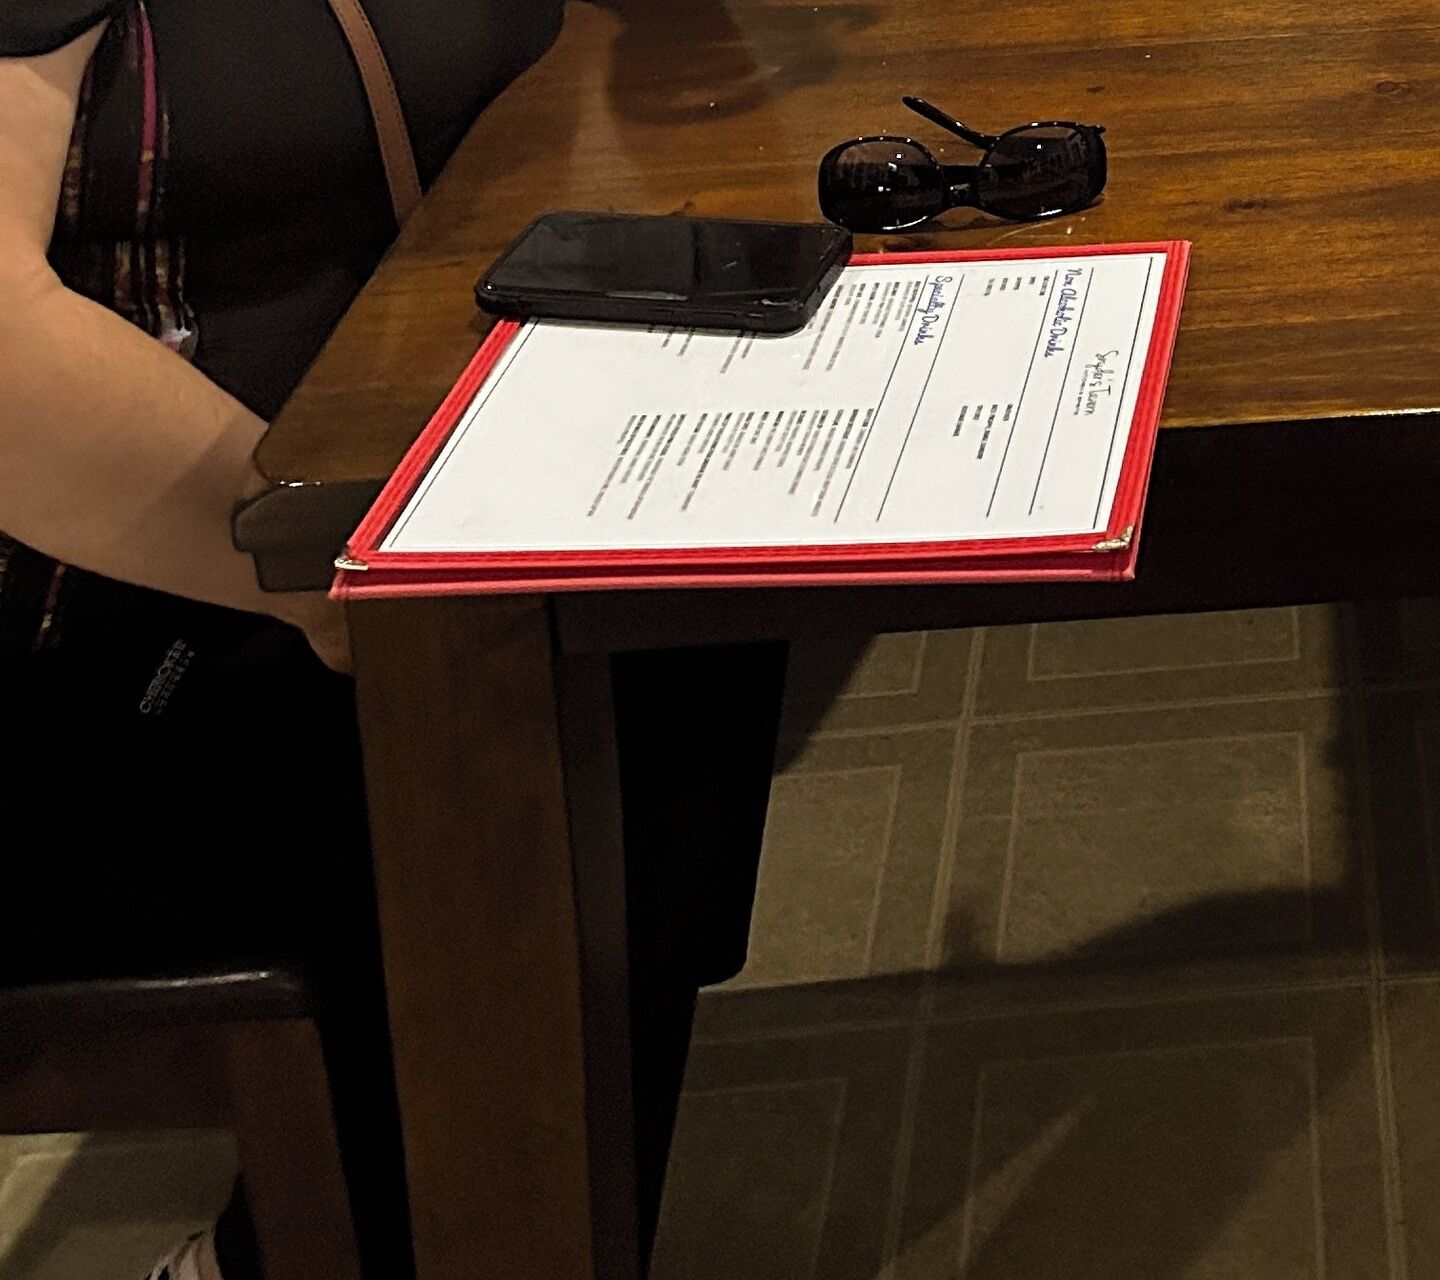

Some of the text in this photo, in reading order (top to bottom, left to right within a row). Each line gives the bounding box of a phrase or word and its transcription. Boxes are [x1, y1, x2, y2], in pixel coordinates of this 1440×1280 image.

[914, 274, 953, 346] Specialty Drinks
[1044, 267, 1083, 359] Non Alcoholic Drinks
